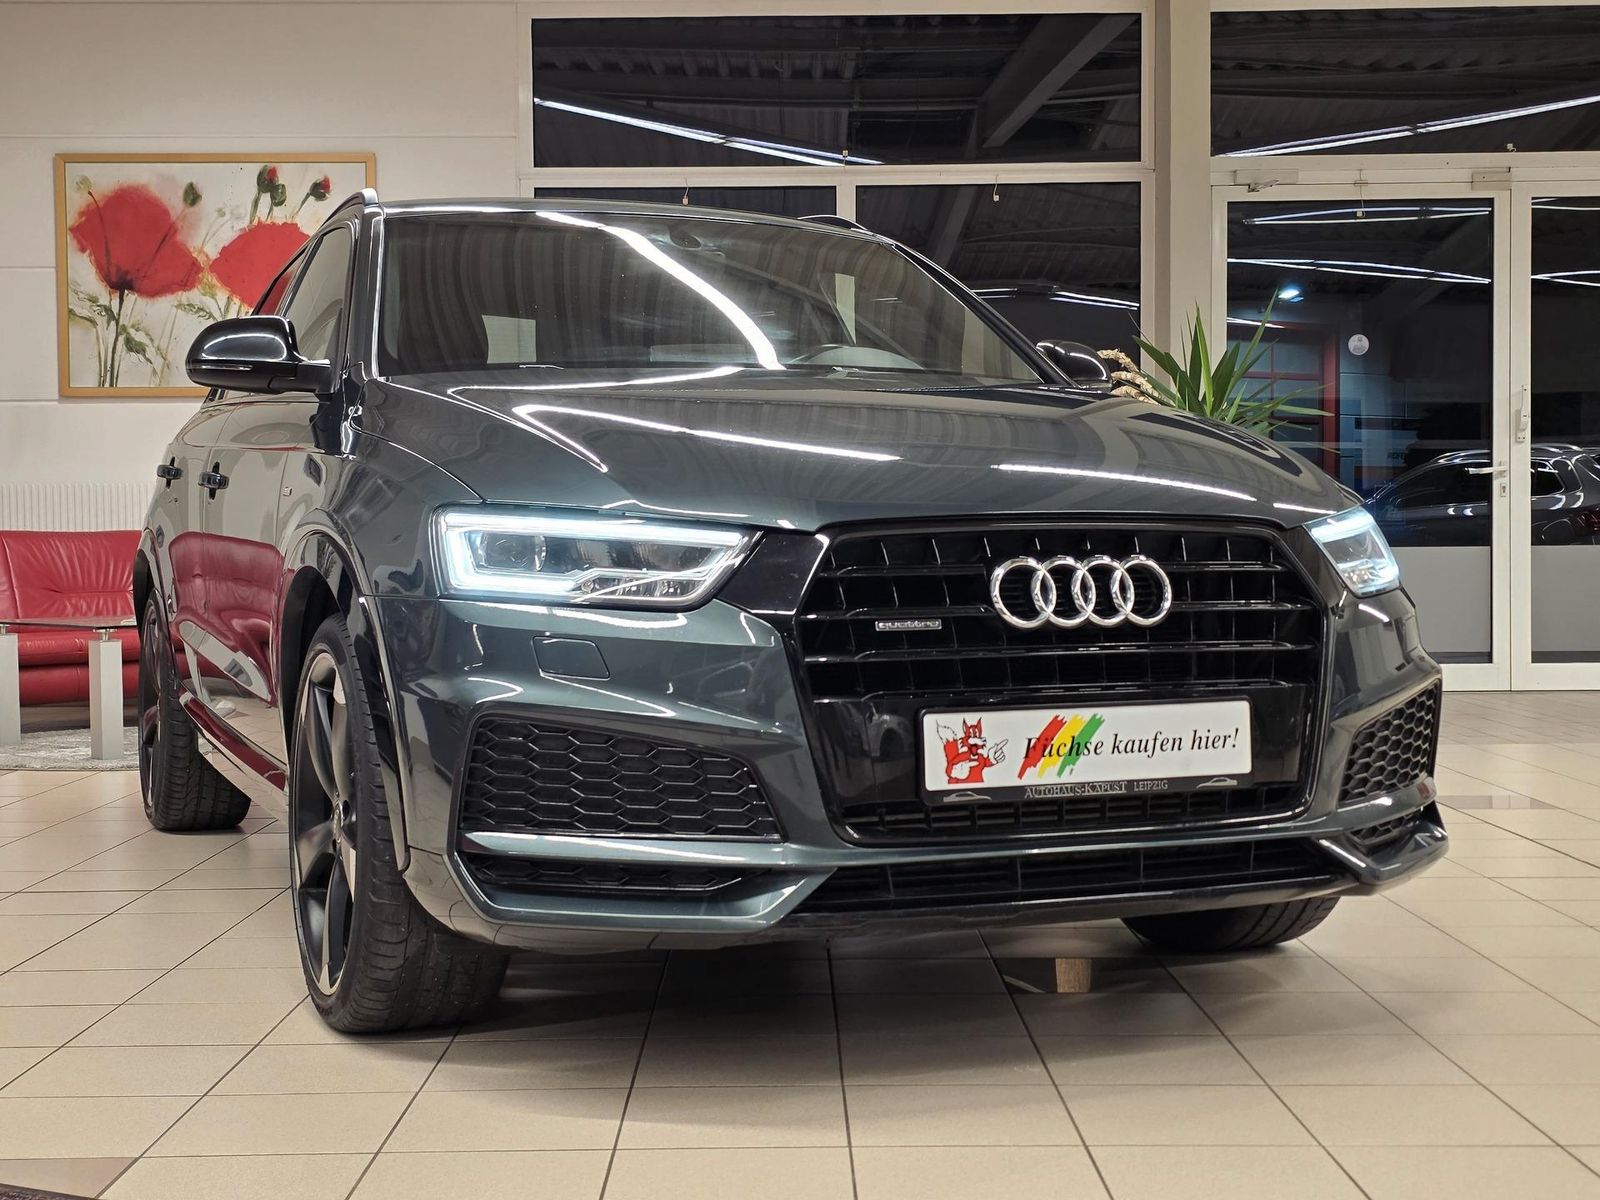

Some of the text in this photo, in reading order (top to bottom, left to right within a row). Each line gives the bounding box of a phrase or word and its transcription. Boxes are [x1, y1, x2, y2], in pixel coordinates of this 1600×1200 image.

[1023, 727, 1239, 759] Füchse kaufen hier!
[1133, 780, 1169, 792] LEIPZIG
